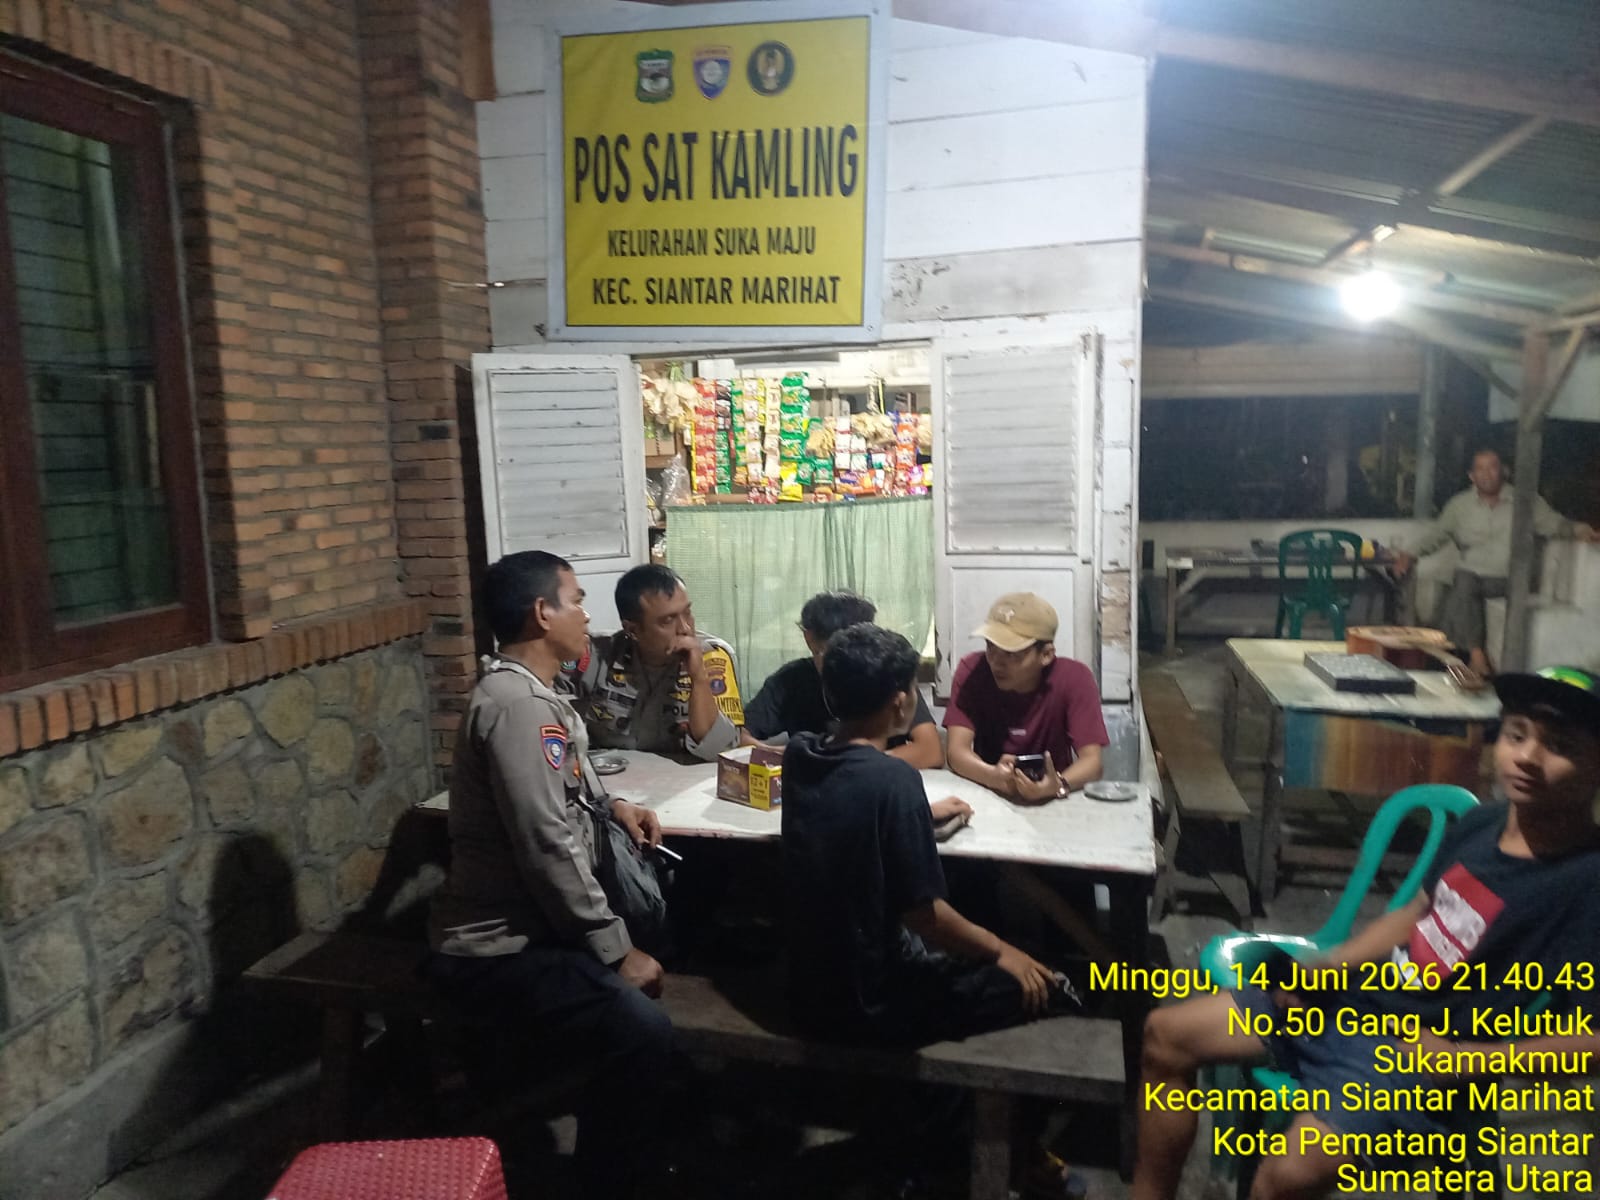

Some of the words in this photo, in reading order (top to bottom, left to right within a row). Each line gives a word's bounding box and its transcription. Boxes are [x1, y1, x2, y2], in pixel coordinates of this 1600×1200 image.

[574, 134, 631, 203] POS
[642, 131, 698, 202] SAT
[711, 124, 859, 200] KAMLING
[608, 227, 708, 257] KELURAHAN
[714, 226, 760, 256] SUKA
[767, 225, 816, 255] MAJU
[593, 276, 638, 305] KEC.
[645, 276, 734, 305] SIANTAR
[742, 276, 841, 305] MARIHAT
[662, 704, 689, 717] POL
